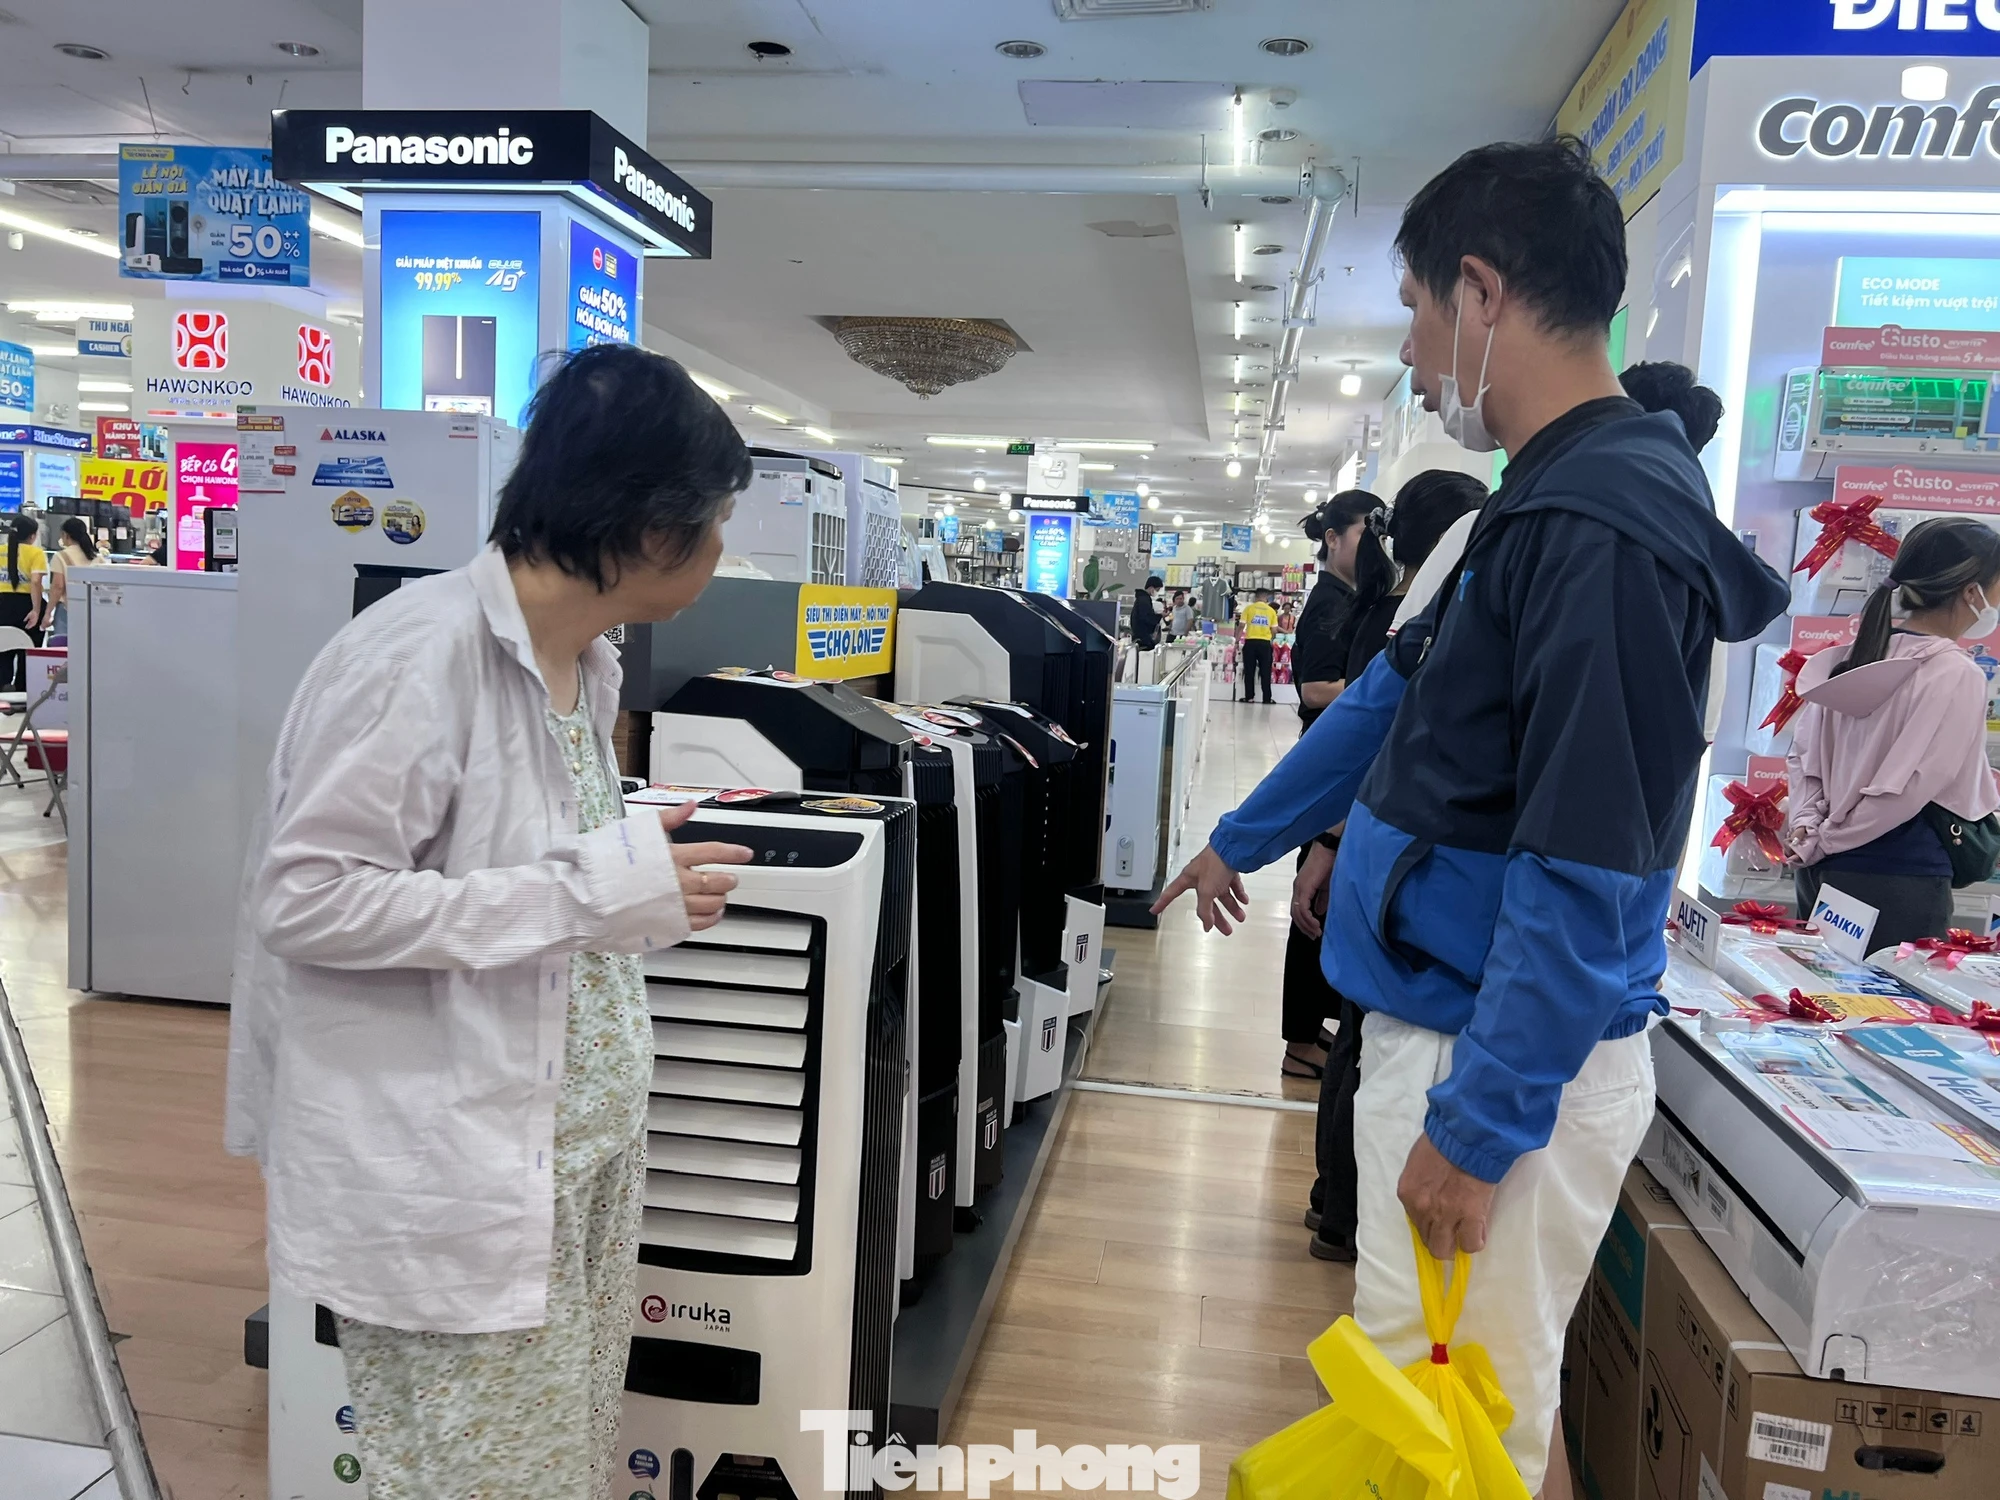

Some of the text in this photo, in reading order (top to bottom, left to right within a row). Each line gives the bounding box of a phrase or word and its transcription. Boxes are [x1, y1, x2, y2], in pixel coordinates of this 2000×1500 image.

[1757, 85, 2000, 160] comf
[326, 126, 534, 165] Panasonic
[614, 145, 695, 232] Panasonic
[208, 193, 303, 221] QUẠT LẠNH
[229, 224, 282, 258] 50
[1861, 277, 1941, 291] ECO MODE
[600, 287, 627, 323] 50%
[1860, 292, 1999, 313] Tiết kiệm vượt trội
[89, 319, 133, 334] THU NGÂ
[1881, 327, 1941, 348] Gusto
[89, 342, 119, 353] CASHIER
[0, 379, 22, 397] 50
[147, 378, 253, 396] HAWONKOO
[112, 422, 131, 431] KHU
[334, 429, 386, 442] ALASKA
[33, 430, 81, 448] BlueStone
[180, 455, 202, 473] BẾP
[202, 459, 218, 473] CÓ
[86, 473, 115, 486] MÃI
[180, 475, 204, 485] CHỌN
[1893, 469, 1953, 490] Gusto
[1023, 496, 1077, 510] Panasonic
[1114, 516, 1130, 526] 50
[806, 602, 821, 624] SIÊU
[821, 606, 833, 628] THỊ
[834, 602, 849, 627] ĐIỆN
[850, 602, 862, 622] MÁY
[866, 603, 877, 626] NỘI
[877, 602, 890, 622] THẤT
[827, 622, 872, 664] CHỢ LỚN
[1677, 900, 1709, 942] AUFIT
[1823, 909, 1865, 941] DAIKIN
[671, 1302, 731, 1325] iruka
[704, 1324, 731, 1333] JAPAN
[342, 1460, 354, 1476] 2
